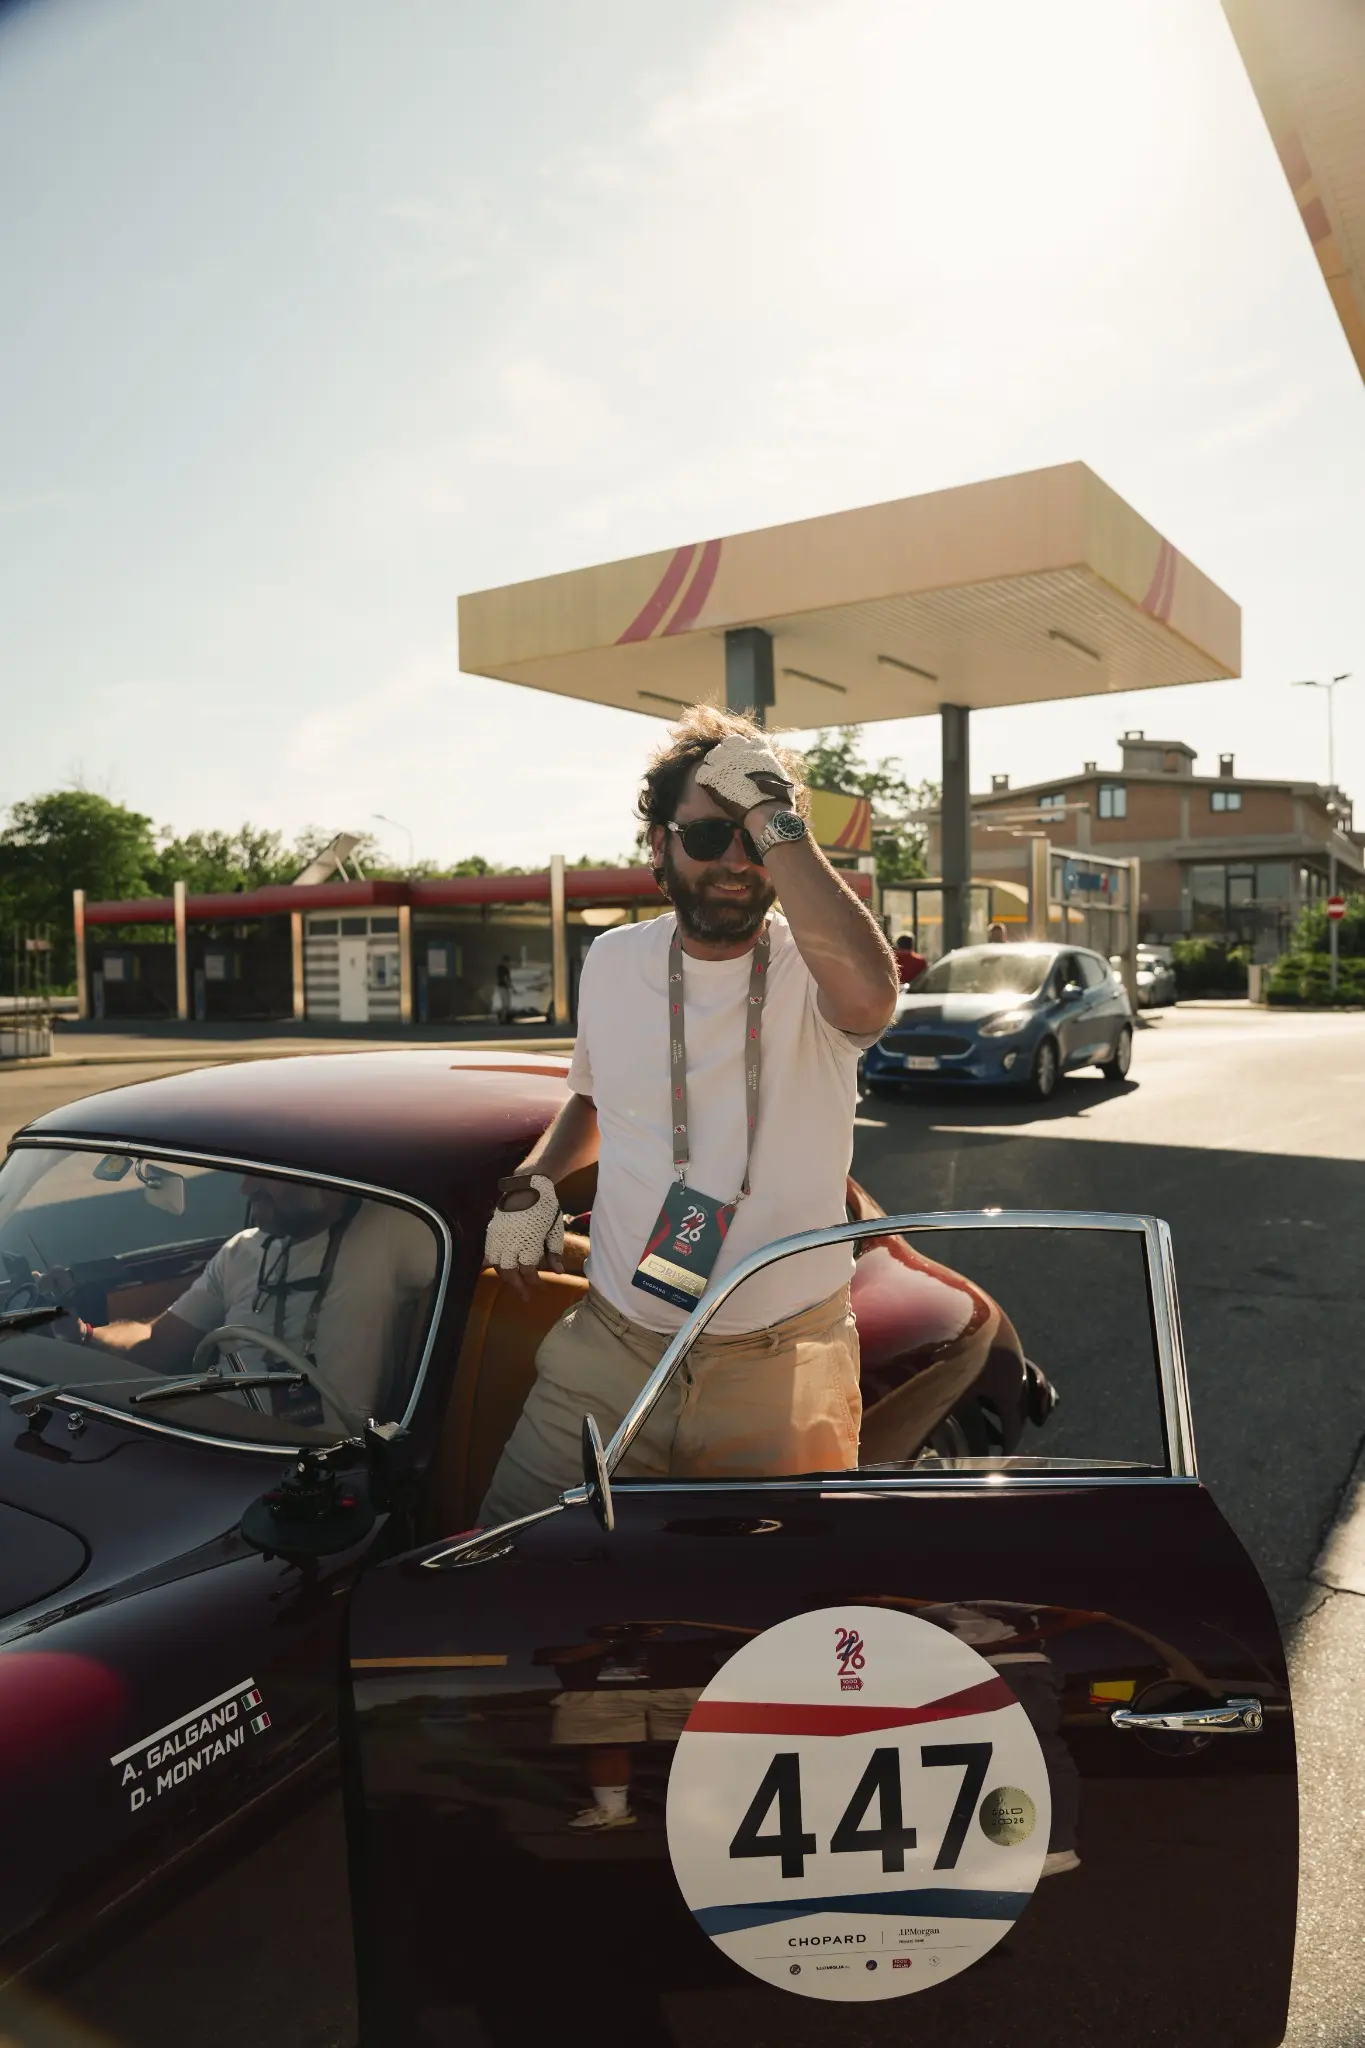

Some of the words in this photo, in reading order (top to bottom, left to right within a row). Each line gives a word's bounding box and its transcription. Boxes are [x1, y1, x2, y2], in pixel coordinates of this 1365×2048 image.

[121, 1763, 143, 1786] A.
[146, 1701, 239, 1769] GALGANO
[130, 1787, 152, 1812] D.
[156, 1725, 244, 1796] MONTANI
[729, 1742, 993, 1879] 447
[992, 1808, 1023, 1816] GOLD
[992, 1818, 1025, 1826] 2026
[788, 1934, 867, 1947] CHOPARD
